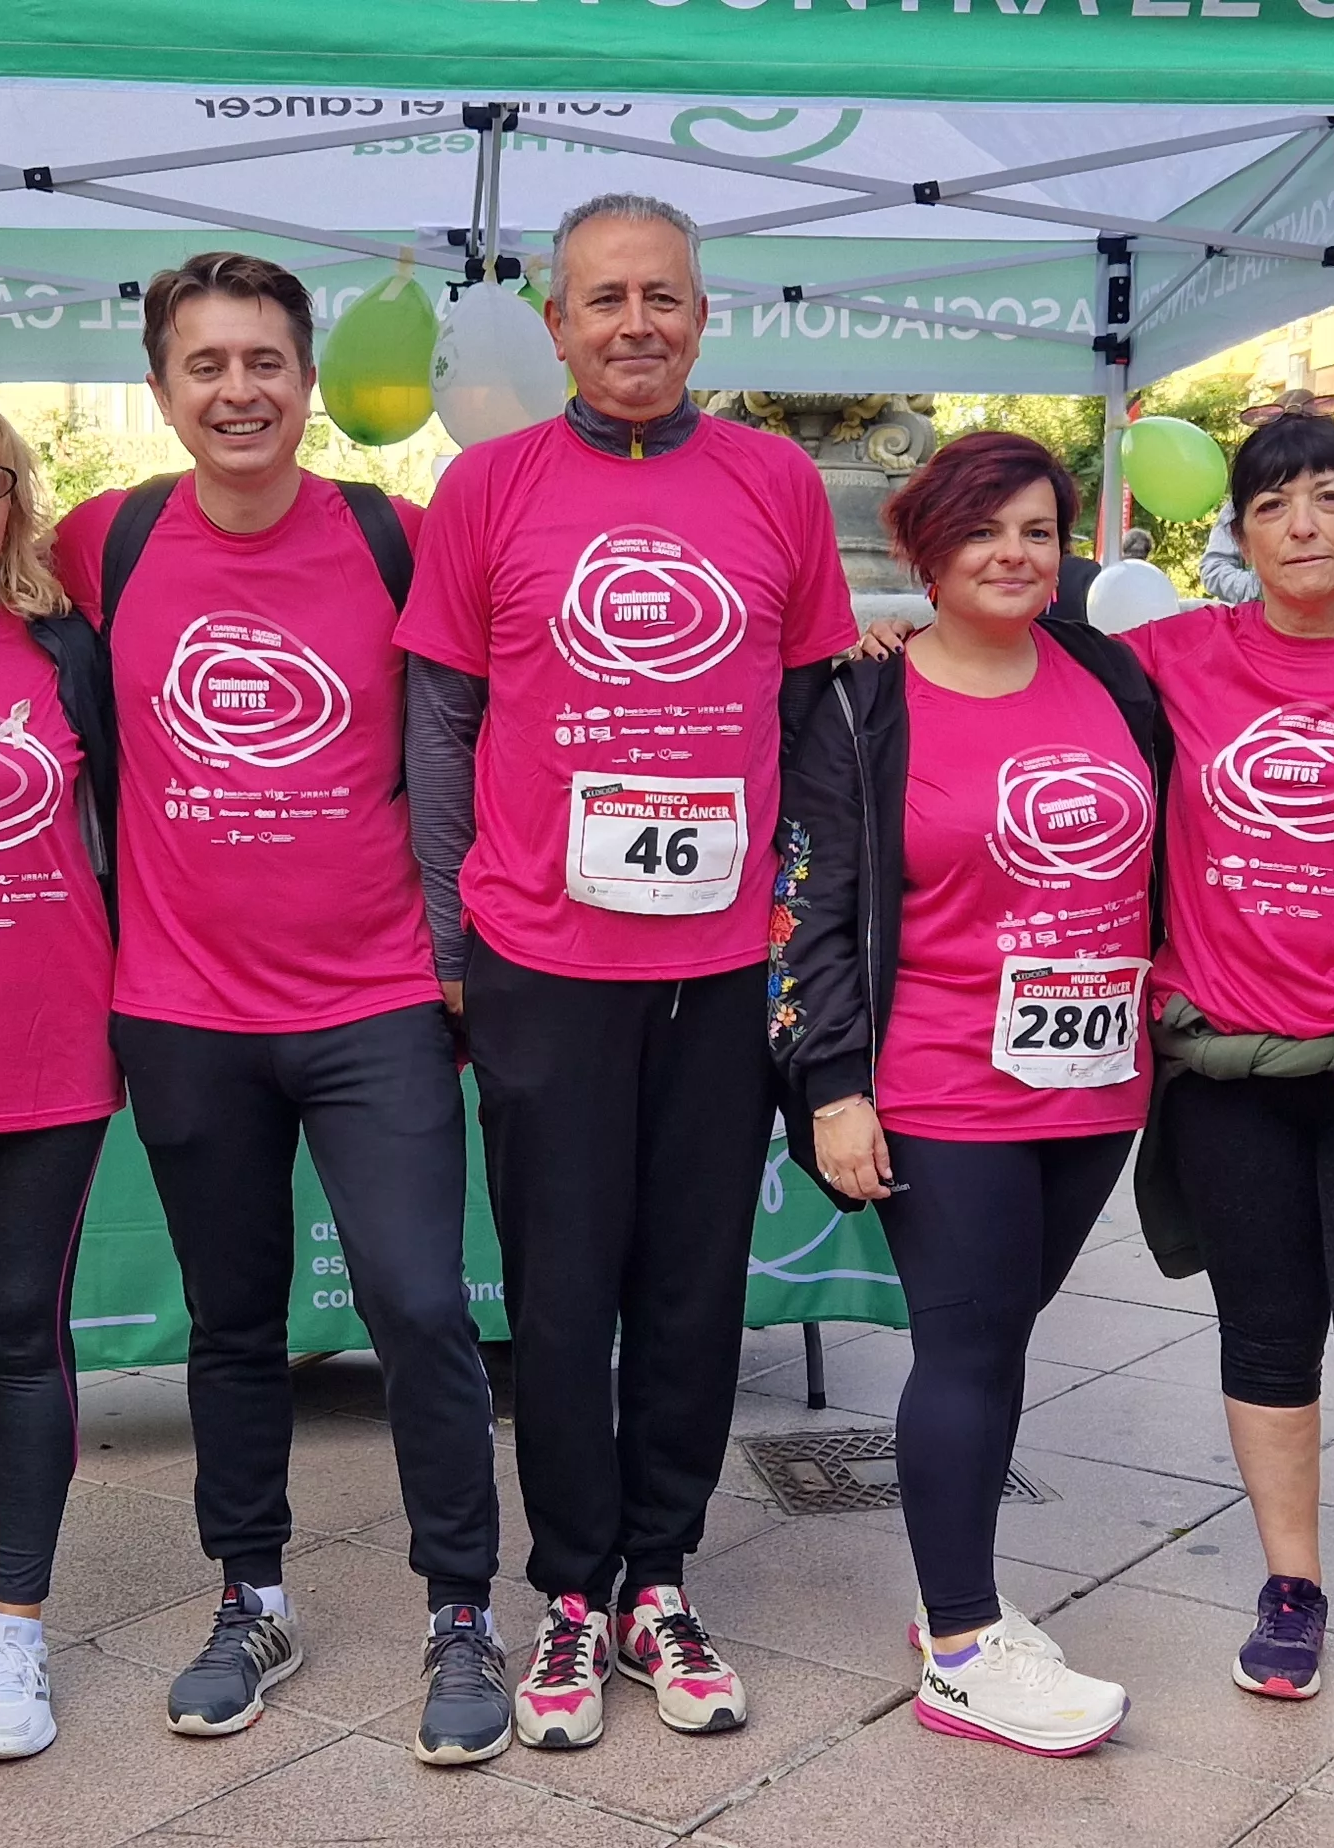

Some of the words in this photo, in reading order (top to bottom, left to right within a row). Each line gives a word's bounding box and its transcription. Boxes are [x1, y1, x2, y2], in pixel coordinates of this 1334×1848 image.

[610, 590, 670, 605] Caminemos
[615, 604, 667, 622] JUNTOS
[208, 677, 270, 691] Caminemos
[213, 692, 266, 708] JUNTOS
[1264, 764, 1320, 783] JUNTOS
[645, 794, 688, 805] HUESCA
[1038, 794, 1097, 815] Caminemos
[593, 801, 655, 818] CONTRA
[659, 807, 675, 818] EL
[679, 804, 730, 819] CÁNCER
[1047, 807, 1098, 830] JUNTOS
[624, 826, 699, 876] 46
[1071, 974, 1107, 984] HUESCA
[1023, 984, 1080, 998] CONTRA
[1082, 985, 1095, 997] EL
[1098, 981, 1131, 997] CÁNCER
[1012, 1001, 1127, 1050] 2801
[924, 1667, 969, 1707] HOKA
